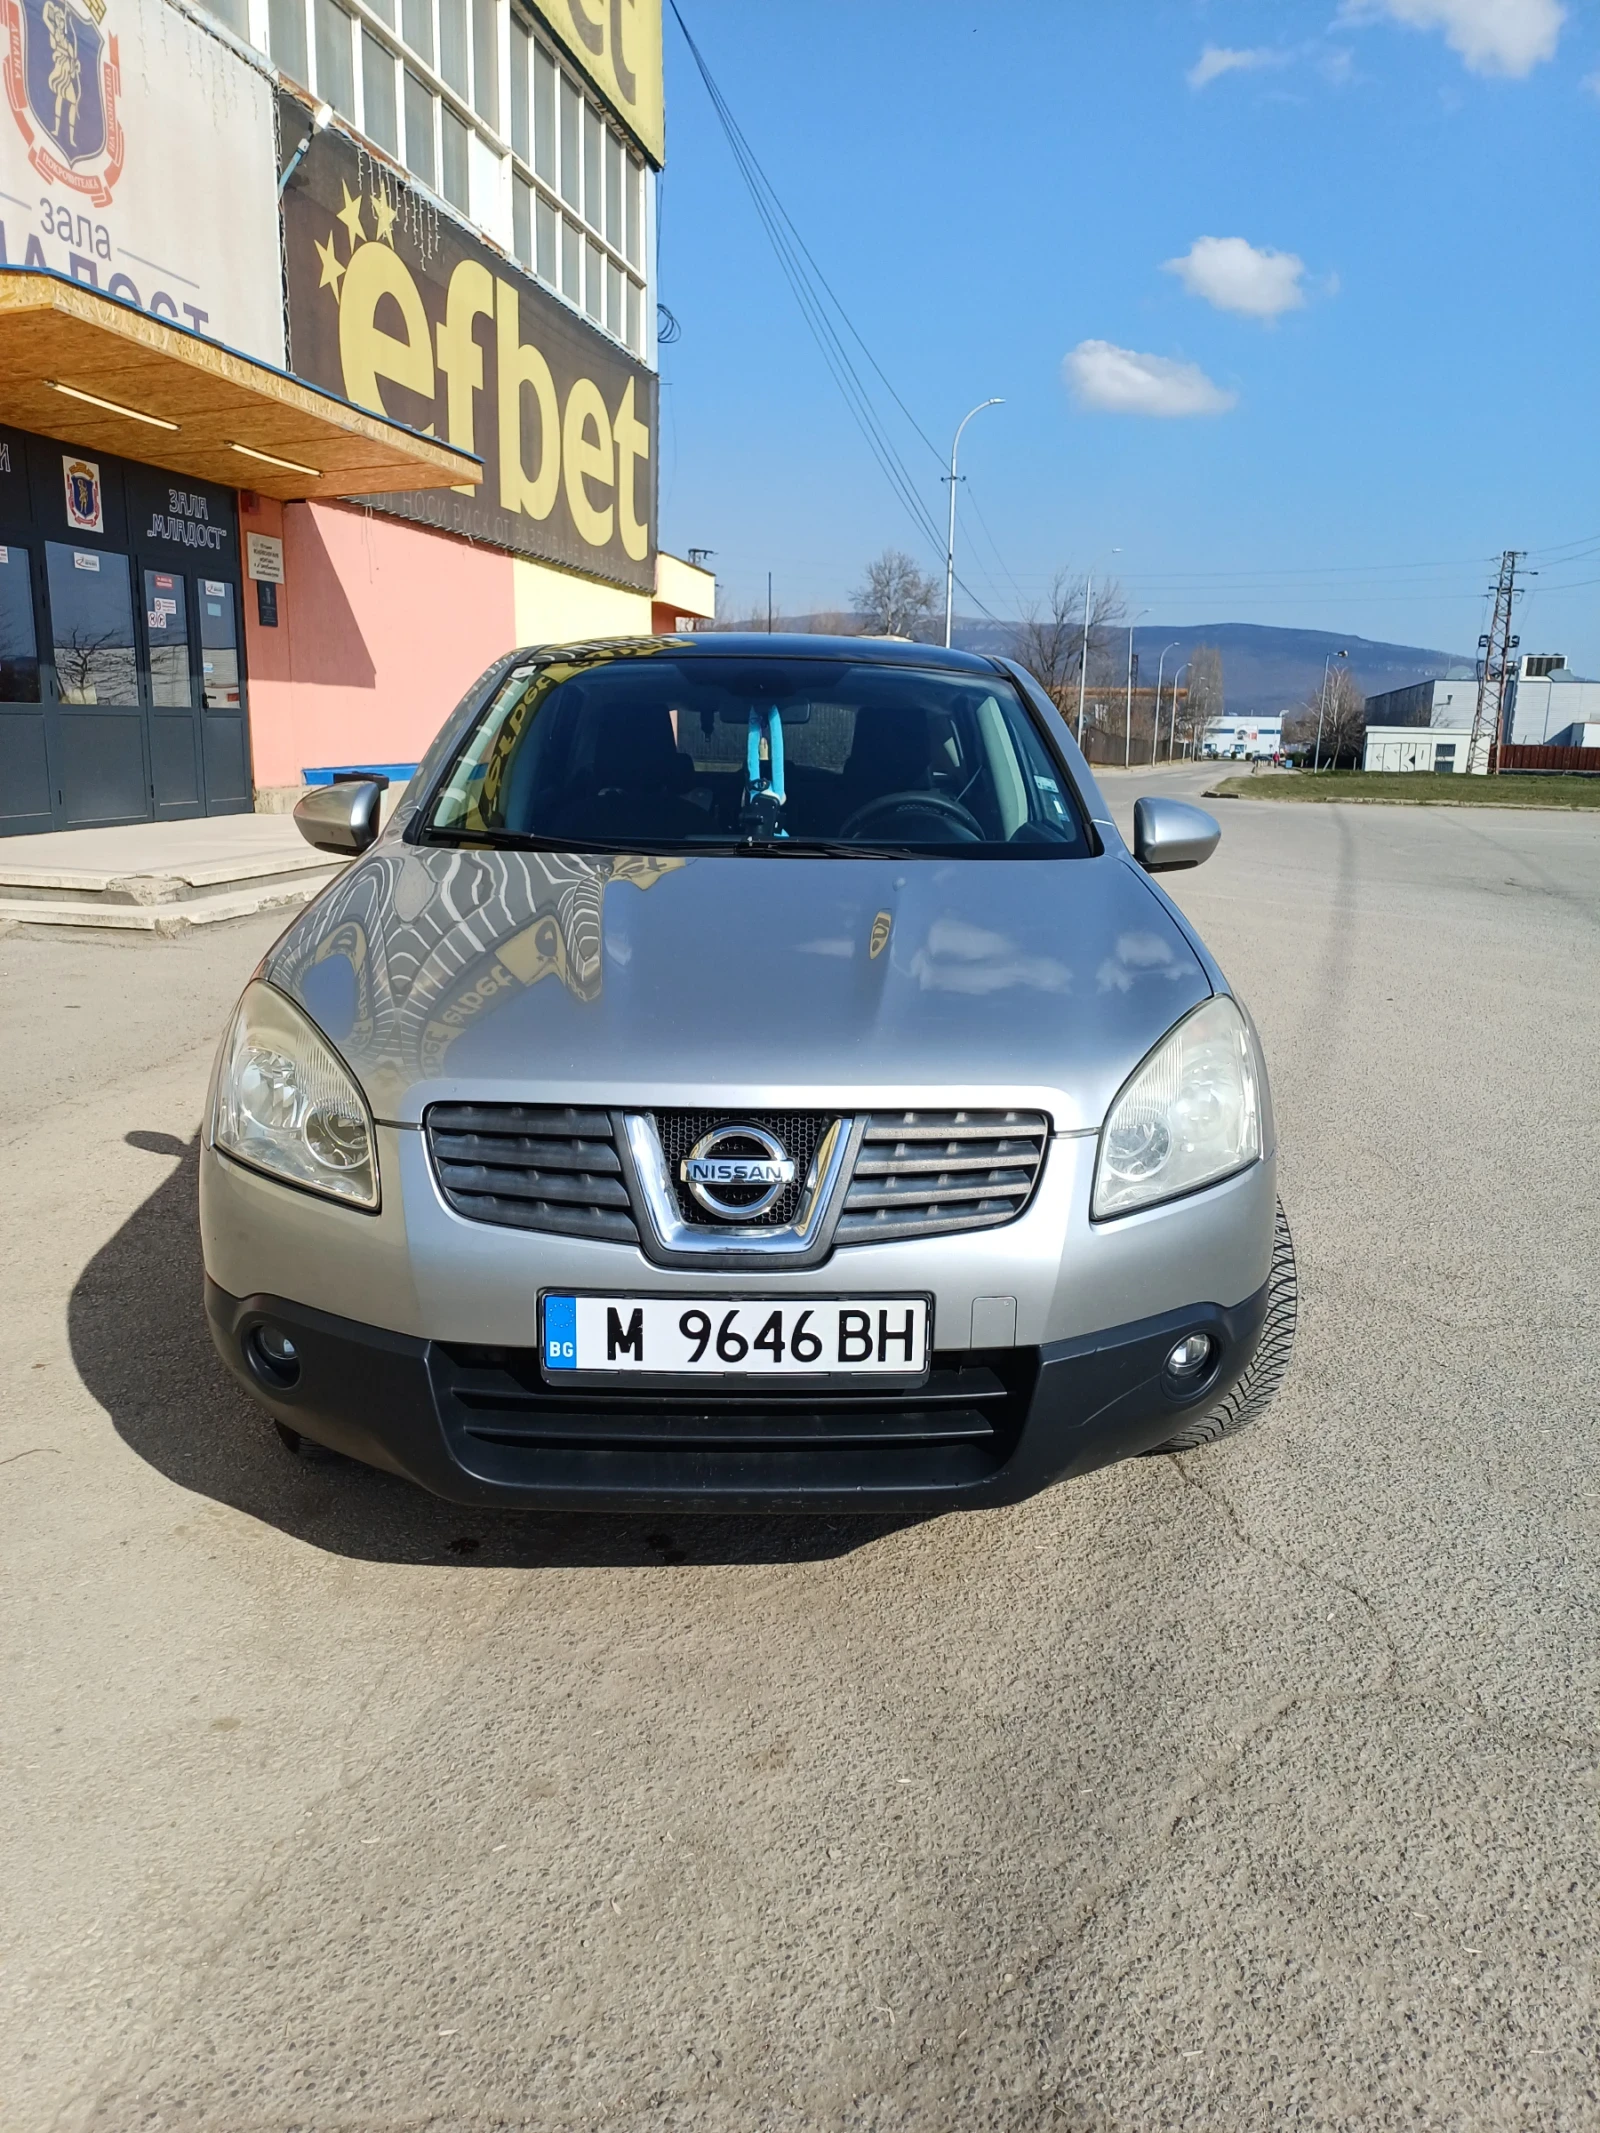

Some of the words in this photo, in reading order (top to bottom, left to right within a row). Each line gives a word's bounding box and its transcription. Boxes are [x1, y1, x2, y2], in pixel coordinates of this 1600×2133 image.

[339, 241, 649, 561] efbet
[168, 488, 209, 520] ЗАЛА
[693, 1165, 782, 1180] NISSAN
[549, 1340, 574, 1358] BG
[606, 1307, 643, 1361] M
[679, 1309, 823, 1363] 9646
[838, 1309, 914, 1363] BH
